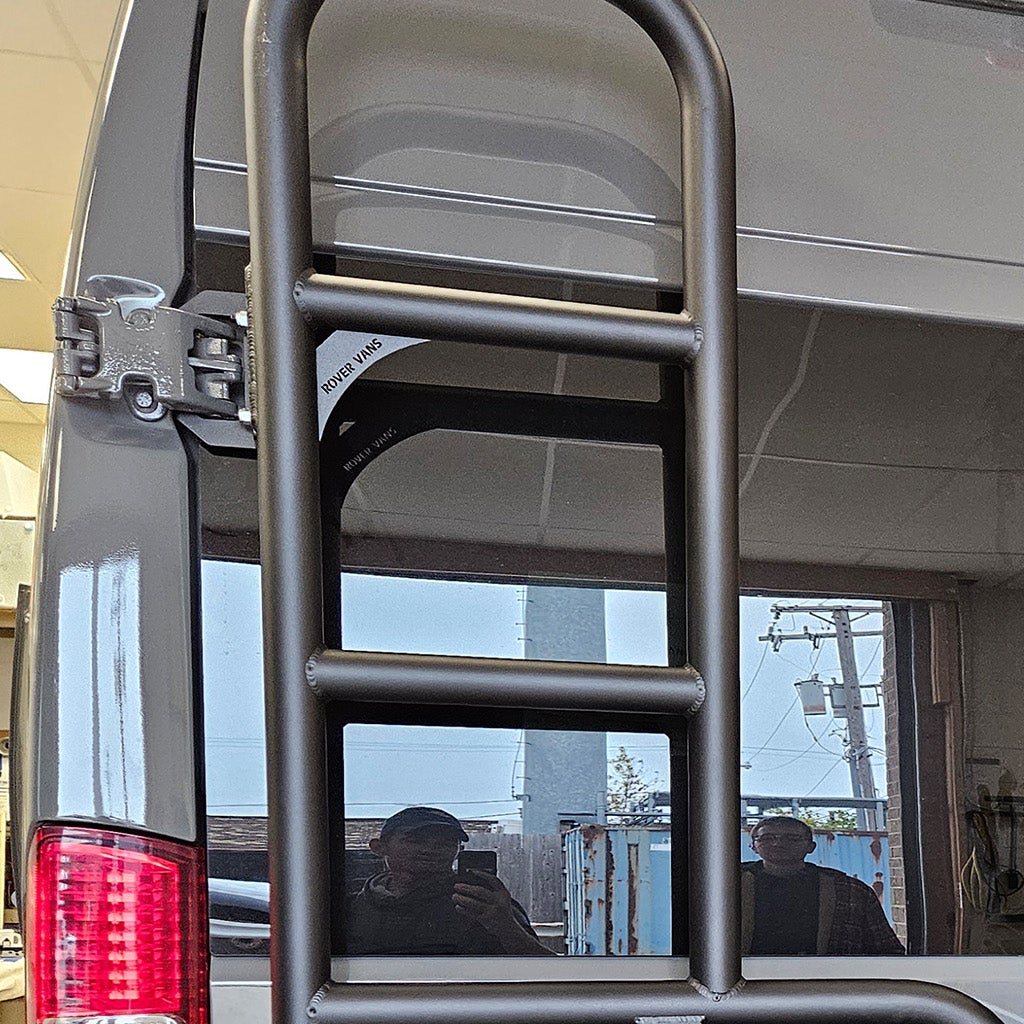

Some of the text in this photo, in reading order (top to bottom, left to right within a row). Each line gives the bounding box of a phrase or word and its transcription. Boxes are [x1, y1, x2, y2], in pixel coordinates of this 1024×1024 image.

[320, 338, 383, 395] ROVER VANS
[343, 427, 398, 472] ROVER VANS
